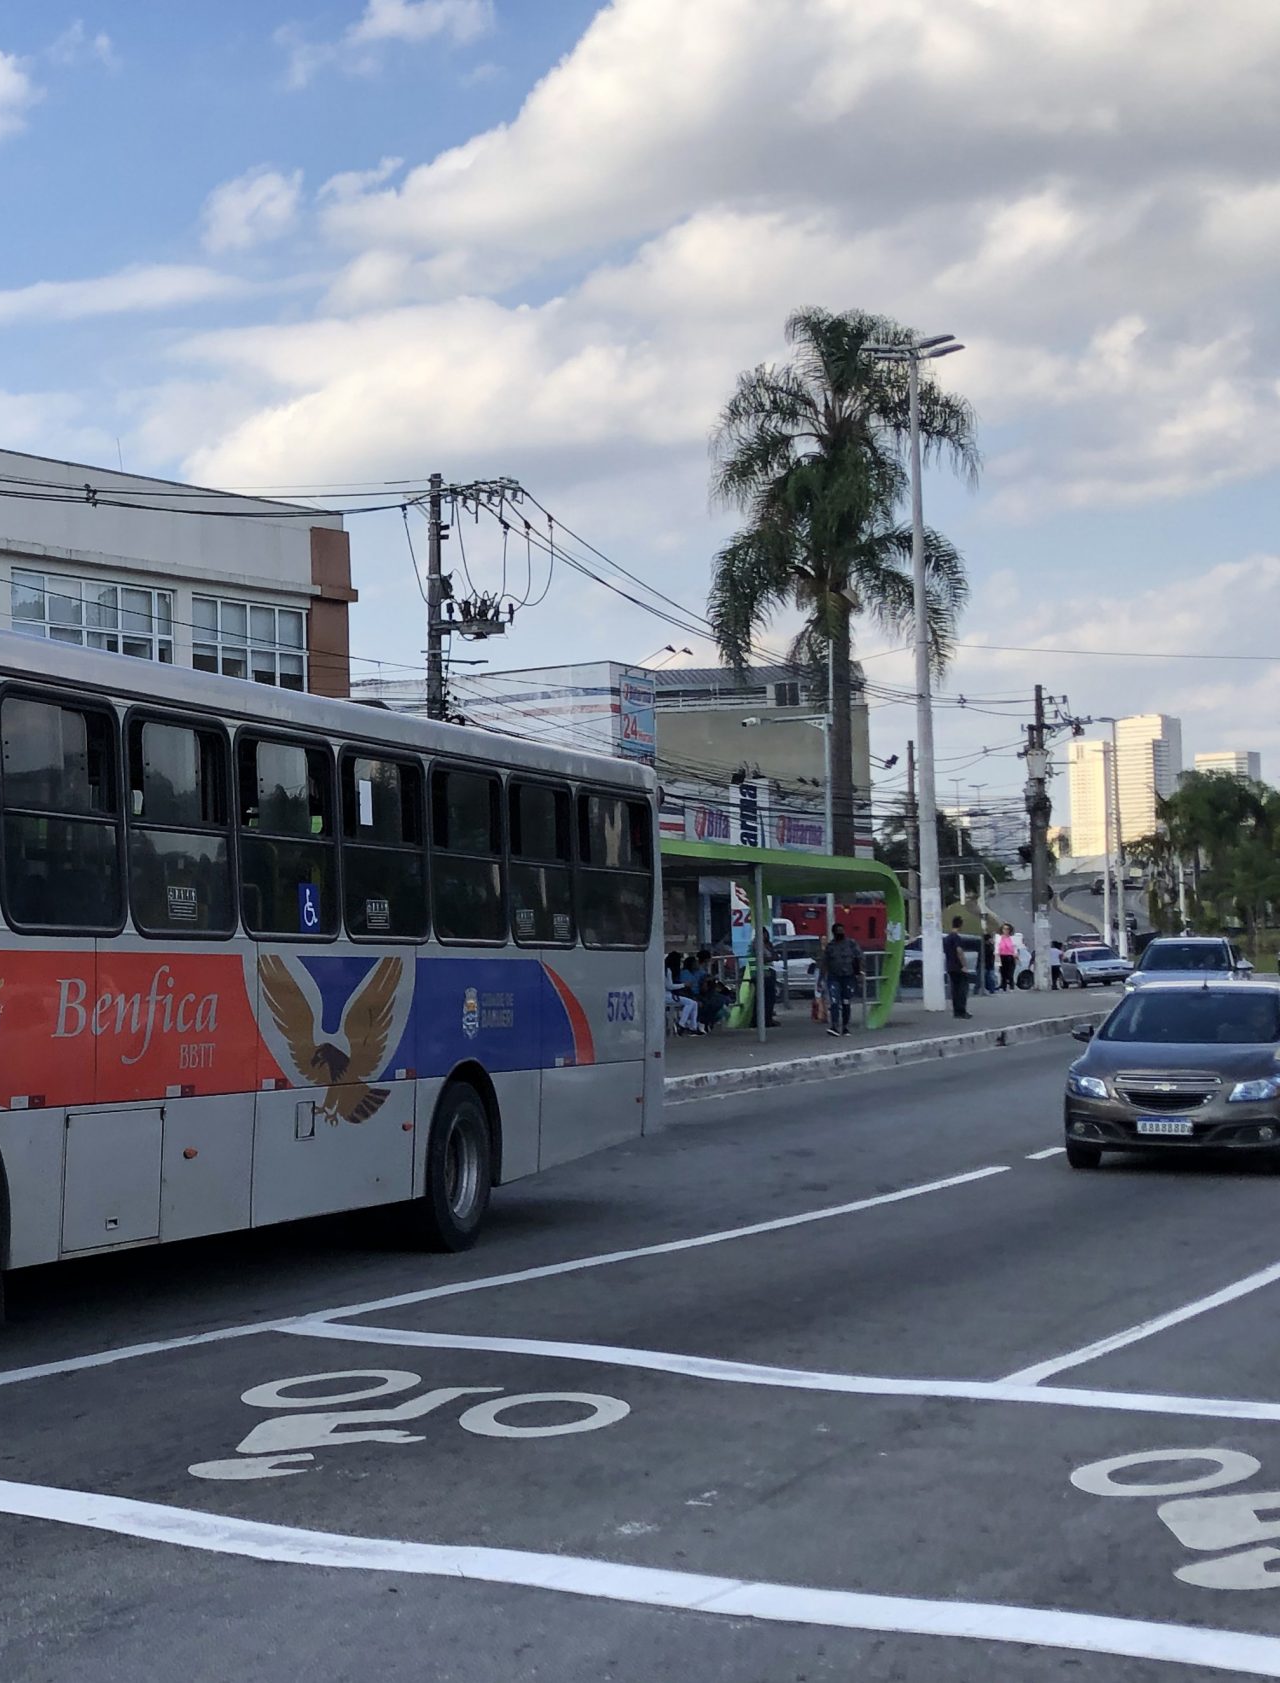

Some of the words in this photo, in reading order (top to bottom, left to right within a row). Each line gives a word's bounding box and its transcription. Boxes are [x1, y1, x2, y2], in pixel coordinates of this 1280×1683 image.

[623, 714, 638, 739] 24
[51, 964, 219, 1065] Benfica
[179, 1043, 216, 1069] BBTT
